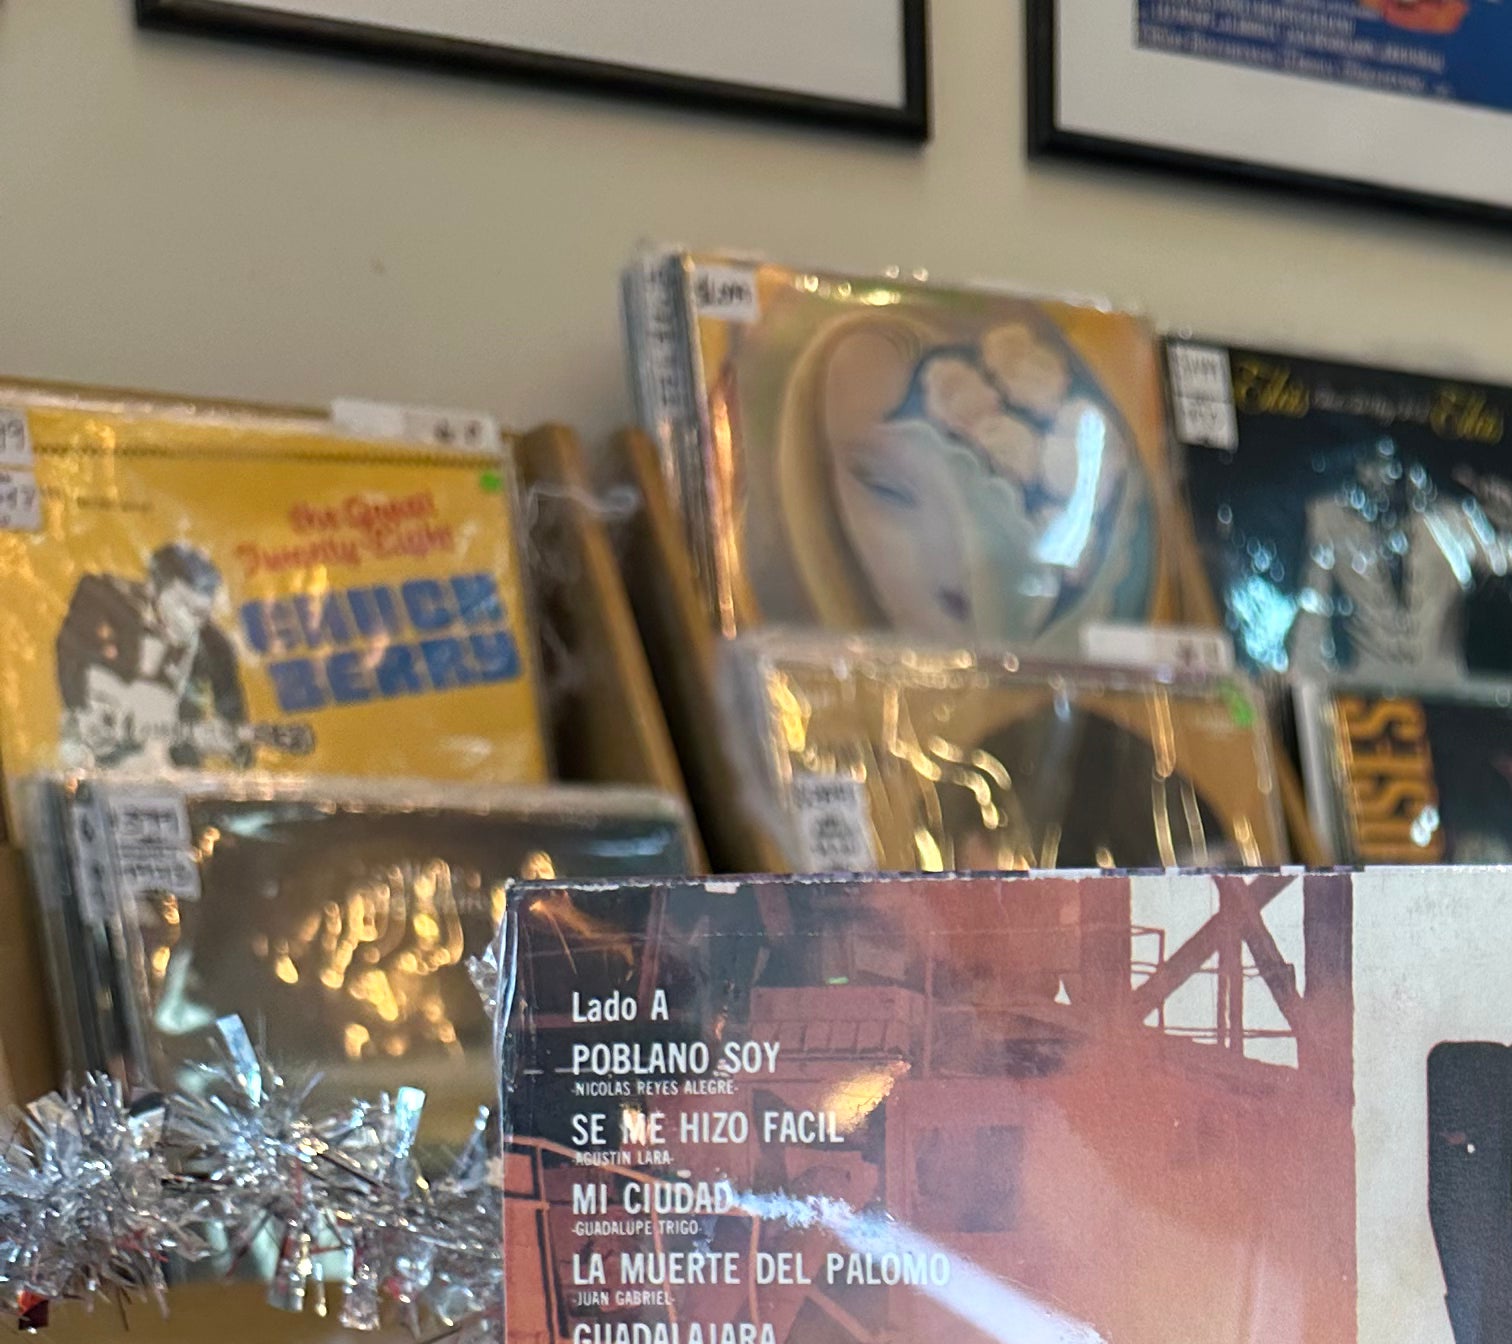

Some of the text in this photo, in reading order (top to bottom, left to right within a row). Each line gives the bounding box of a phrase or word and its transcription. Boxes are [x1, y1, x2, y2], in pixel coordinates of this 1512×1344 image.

[270, 630, 521, 714] BERRY
[572, 990, 669, 1022] Lado A
[572, 1042, 780, 1075] POBLANO SOY
[637, 1082, 678, 1095] REYES
[572, 1111, 844, 1145] SE ME HIZO FACIL
[572, 1181, 735, 1215] MI CIUDAD
[572, 1253, 950, 1286] LA MUERTE DEL PALOMO
